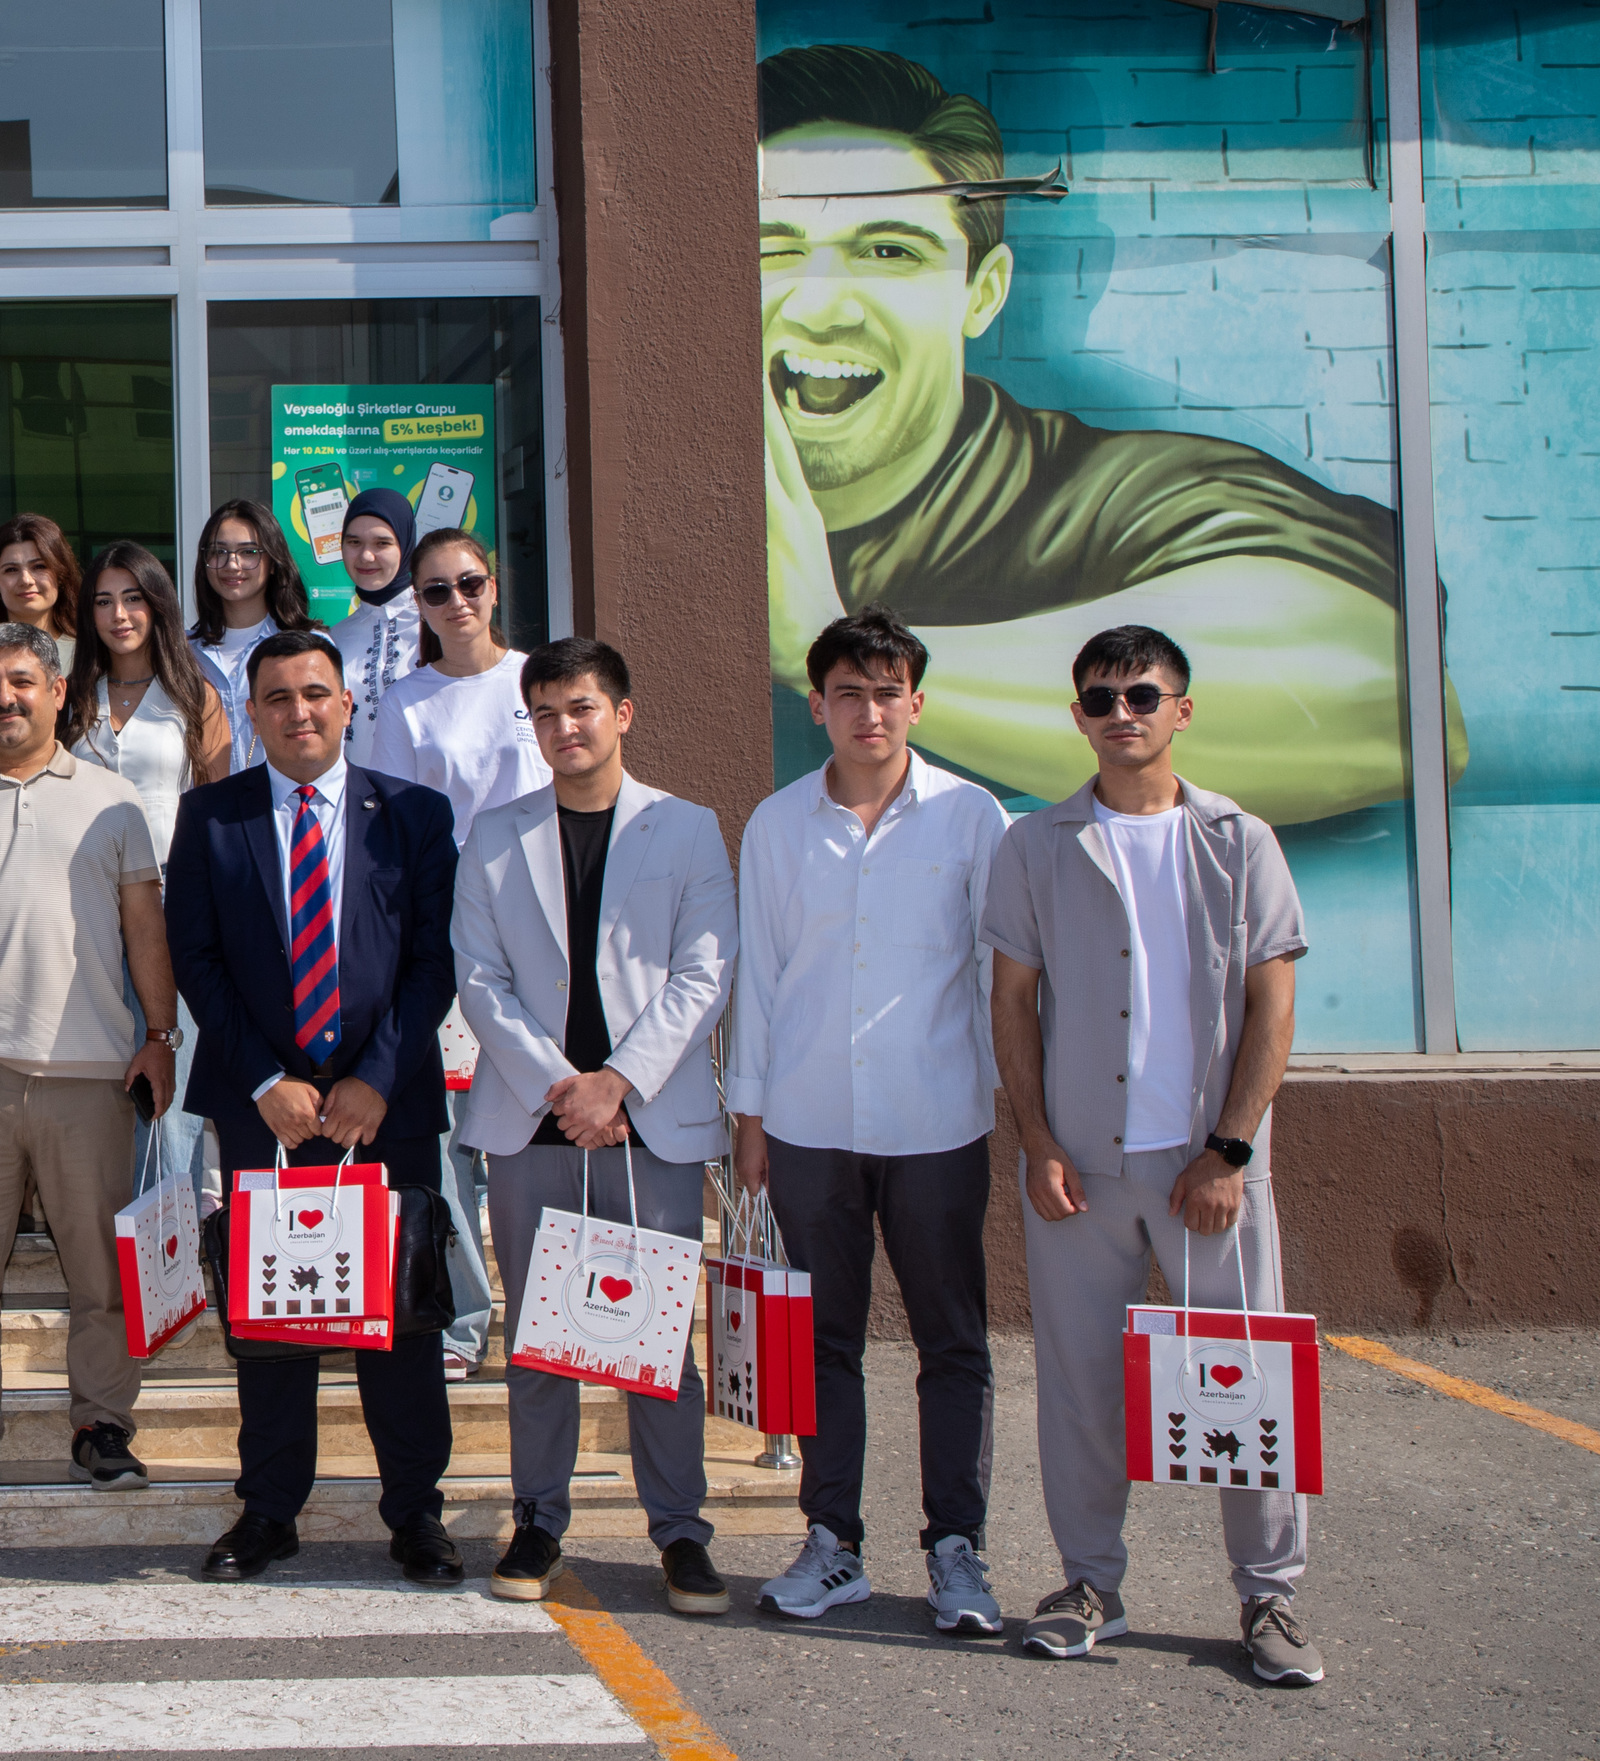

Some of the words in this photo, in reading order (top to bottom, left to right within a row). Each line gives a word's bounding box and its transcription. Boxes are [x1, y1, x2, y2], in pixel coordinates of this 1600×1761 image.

[284, 403, 354, 417] Veysəloğlu
[357, 403, 412, 417] Şirkətlər
[415, 404, 456, 417] Qrupu
[284, 424, 380, 438] əməkdaşlarına
[391, 423, 413, 436] 5%
[417, 419, 477, 436] keşbek!
[284, 447, 300, 455] Hər
[349, 446, 372, 454] üzəri
[374, 446, 438, 456] alış-verişlərdə
[440, 446, 483, 456] keçərlidir
[354, 470, 360, 479] 1
[312, 588, 319, 598] 3
[289, 1210, 294, 1231] I
[586, 1272, 596, 1298] I
[583, 1301, 630, 1317] Azerbaijan
[1199, 1363, 1206, 1388] I
[1199, 1390, 1246, 1400] Azerbaijan
